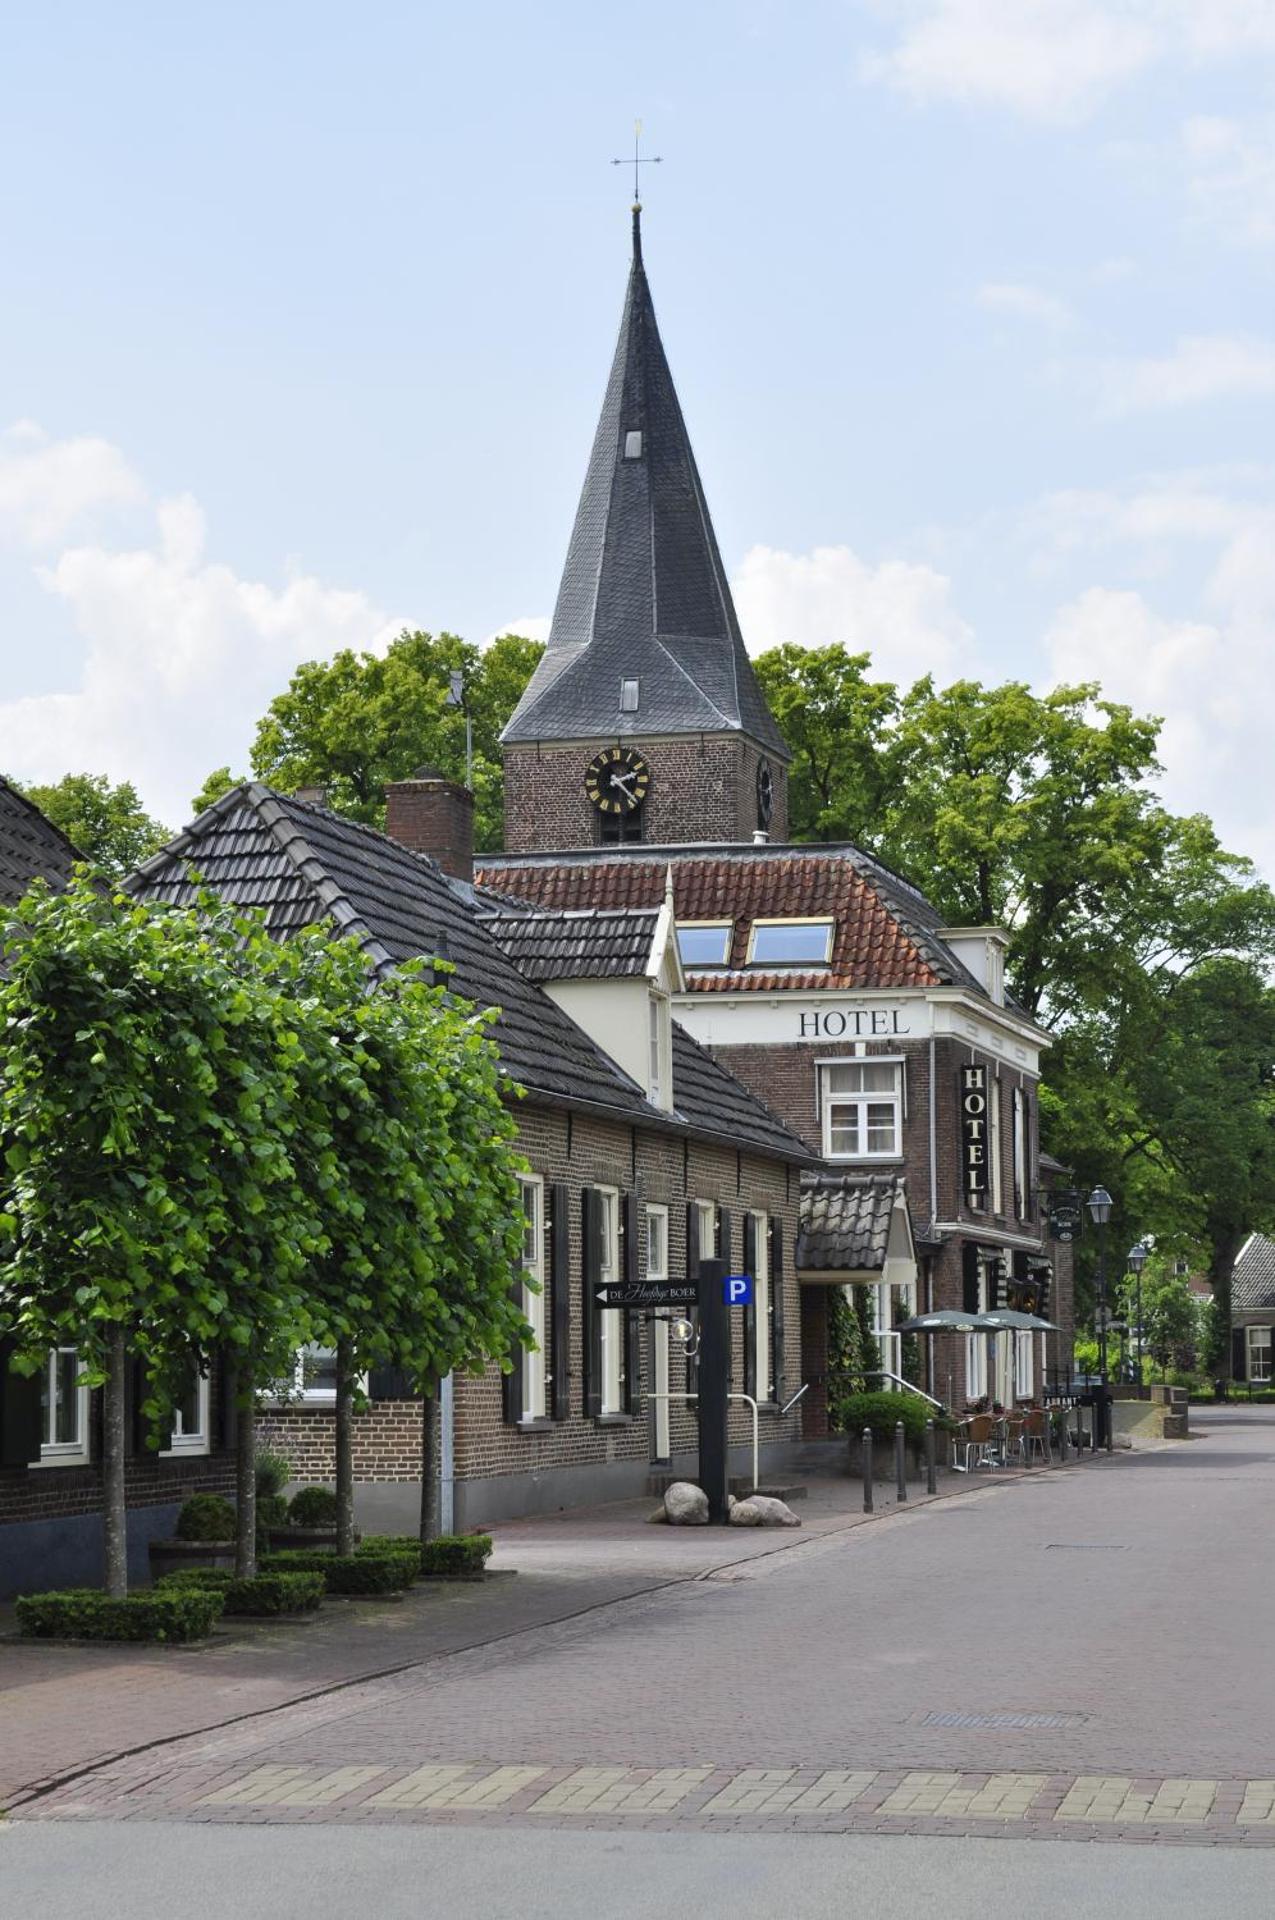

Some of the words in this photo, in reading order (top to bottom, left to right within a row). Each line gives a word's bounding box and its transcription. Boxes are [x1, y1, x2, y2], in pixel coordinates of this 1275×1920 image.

[798, 1010, 911, 1038] HOTEL
[964, 1069, 985, 1190] HOTEL
[609, 1290, 624, 1300] DE
[670, 1287, 696, 1298] BOER
[730, 1279, 747, 1302] P
